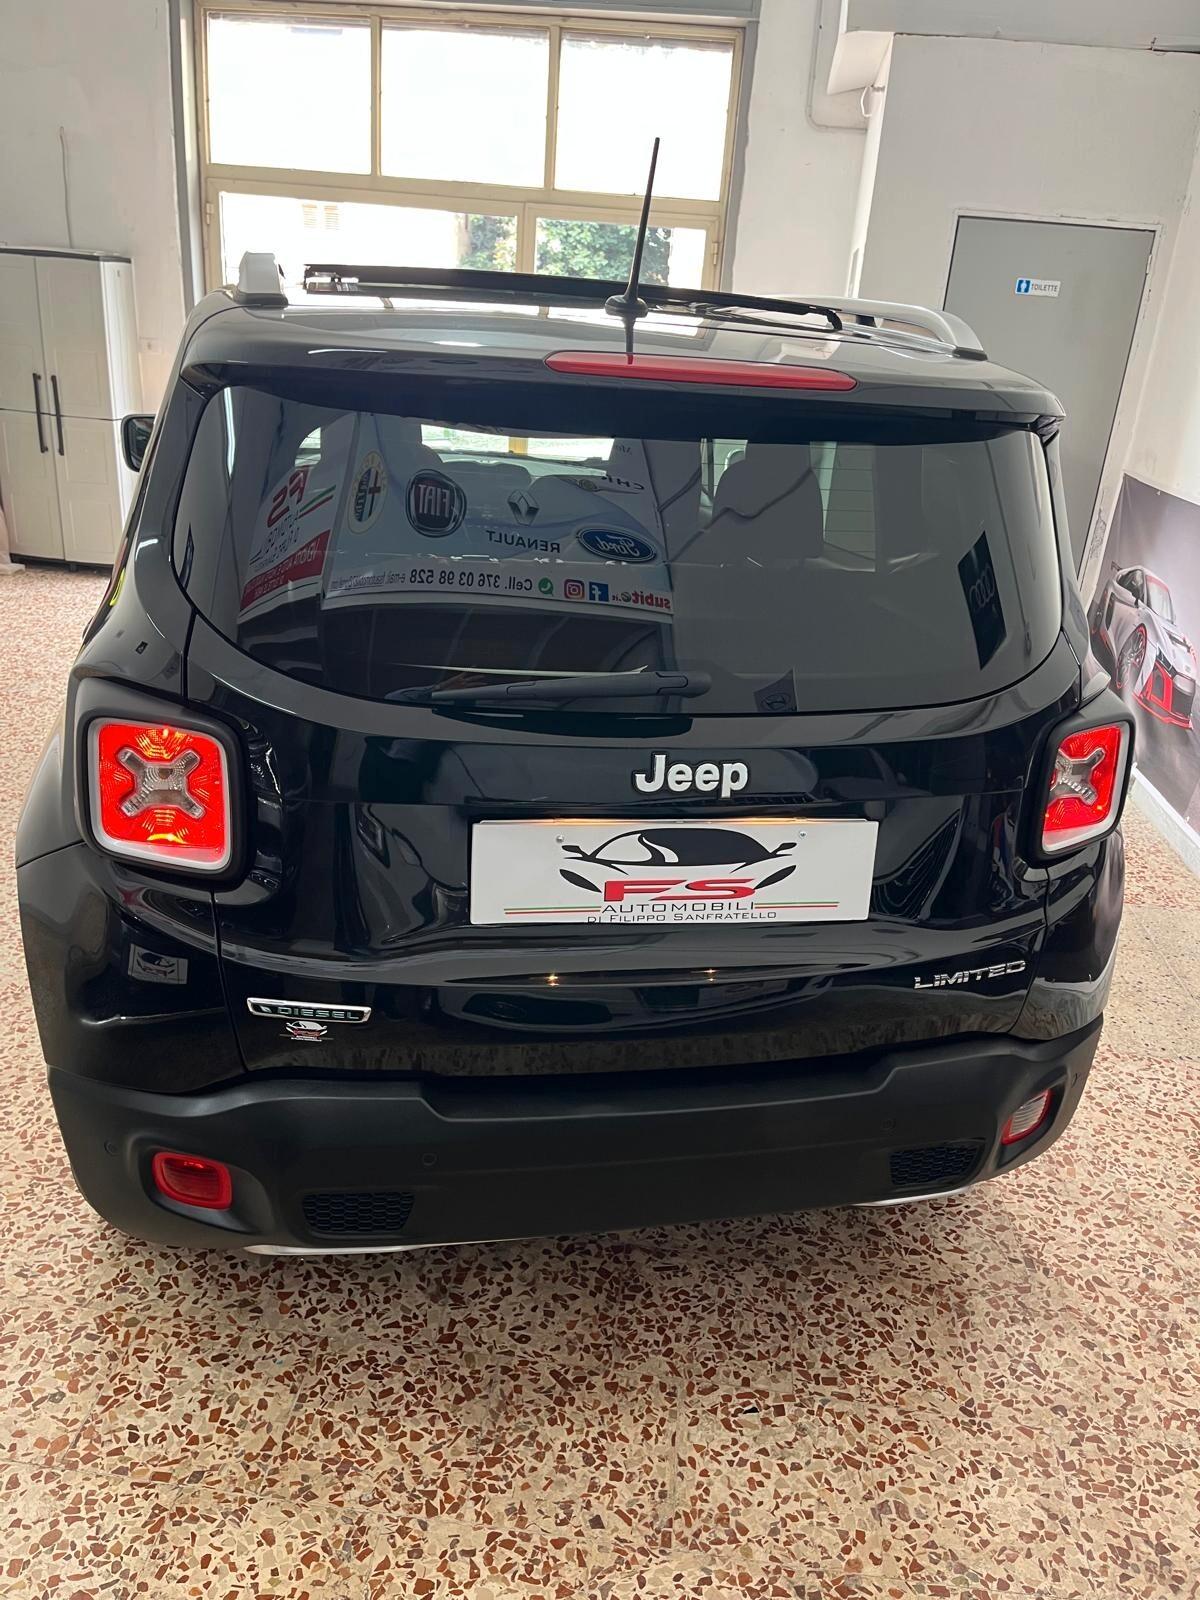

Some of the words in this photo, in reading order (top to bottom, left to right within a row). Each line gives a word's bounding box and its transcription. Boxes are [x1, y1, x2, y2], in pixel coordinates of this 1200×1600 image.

[634, 752, 750, 799] Jeep
[603, 878, 757, 902] FS
[602, 901, 755, 914] AUTOMOBILI
[609, 914, 667, 922] FILIPPO
[673, 911, 778, 921] SANFRATELLO
[913, 960, 1027, 990] LIMITED
[277, 1006, 360, 1020] DIESEL
